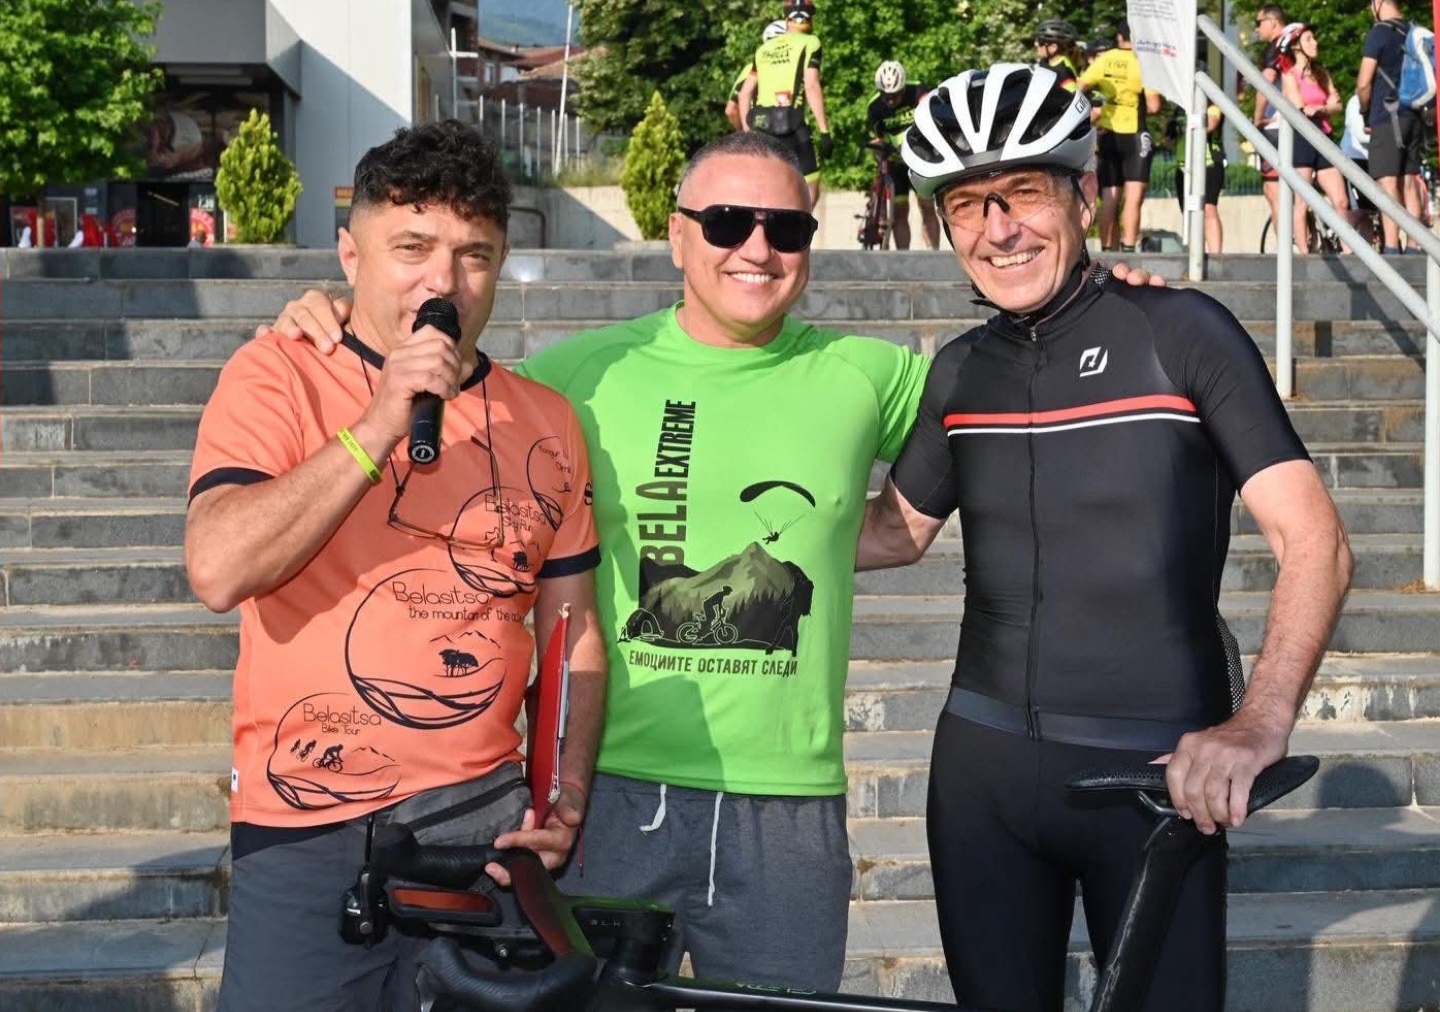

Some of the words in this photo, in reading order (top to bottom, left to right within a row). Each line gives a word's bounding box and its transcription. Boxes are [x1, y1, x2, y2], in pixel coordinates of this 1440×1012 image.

[654, 399, 696, 478] EXTREME
[392, 581, 490, 605] Belasitsa
[409, 606, 429, 619] the
[480, 607, 492, 621] of
[697, 658, 757, 676] ОСТАВЯТ
[303, 703, 382, 726] Belasitsa
